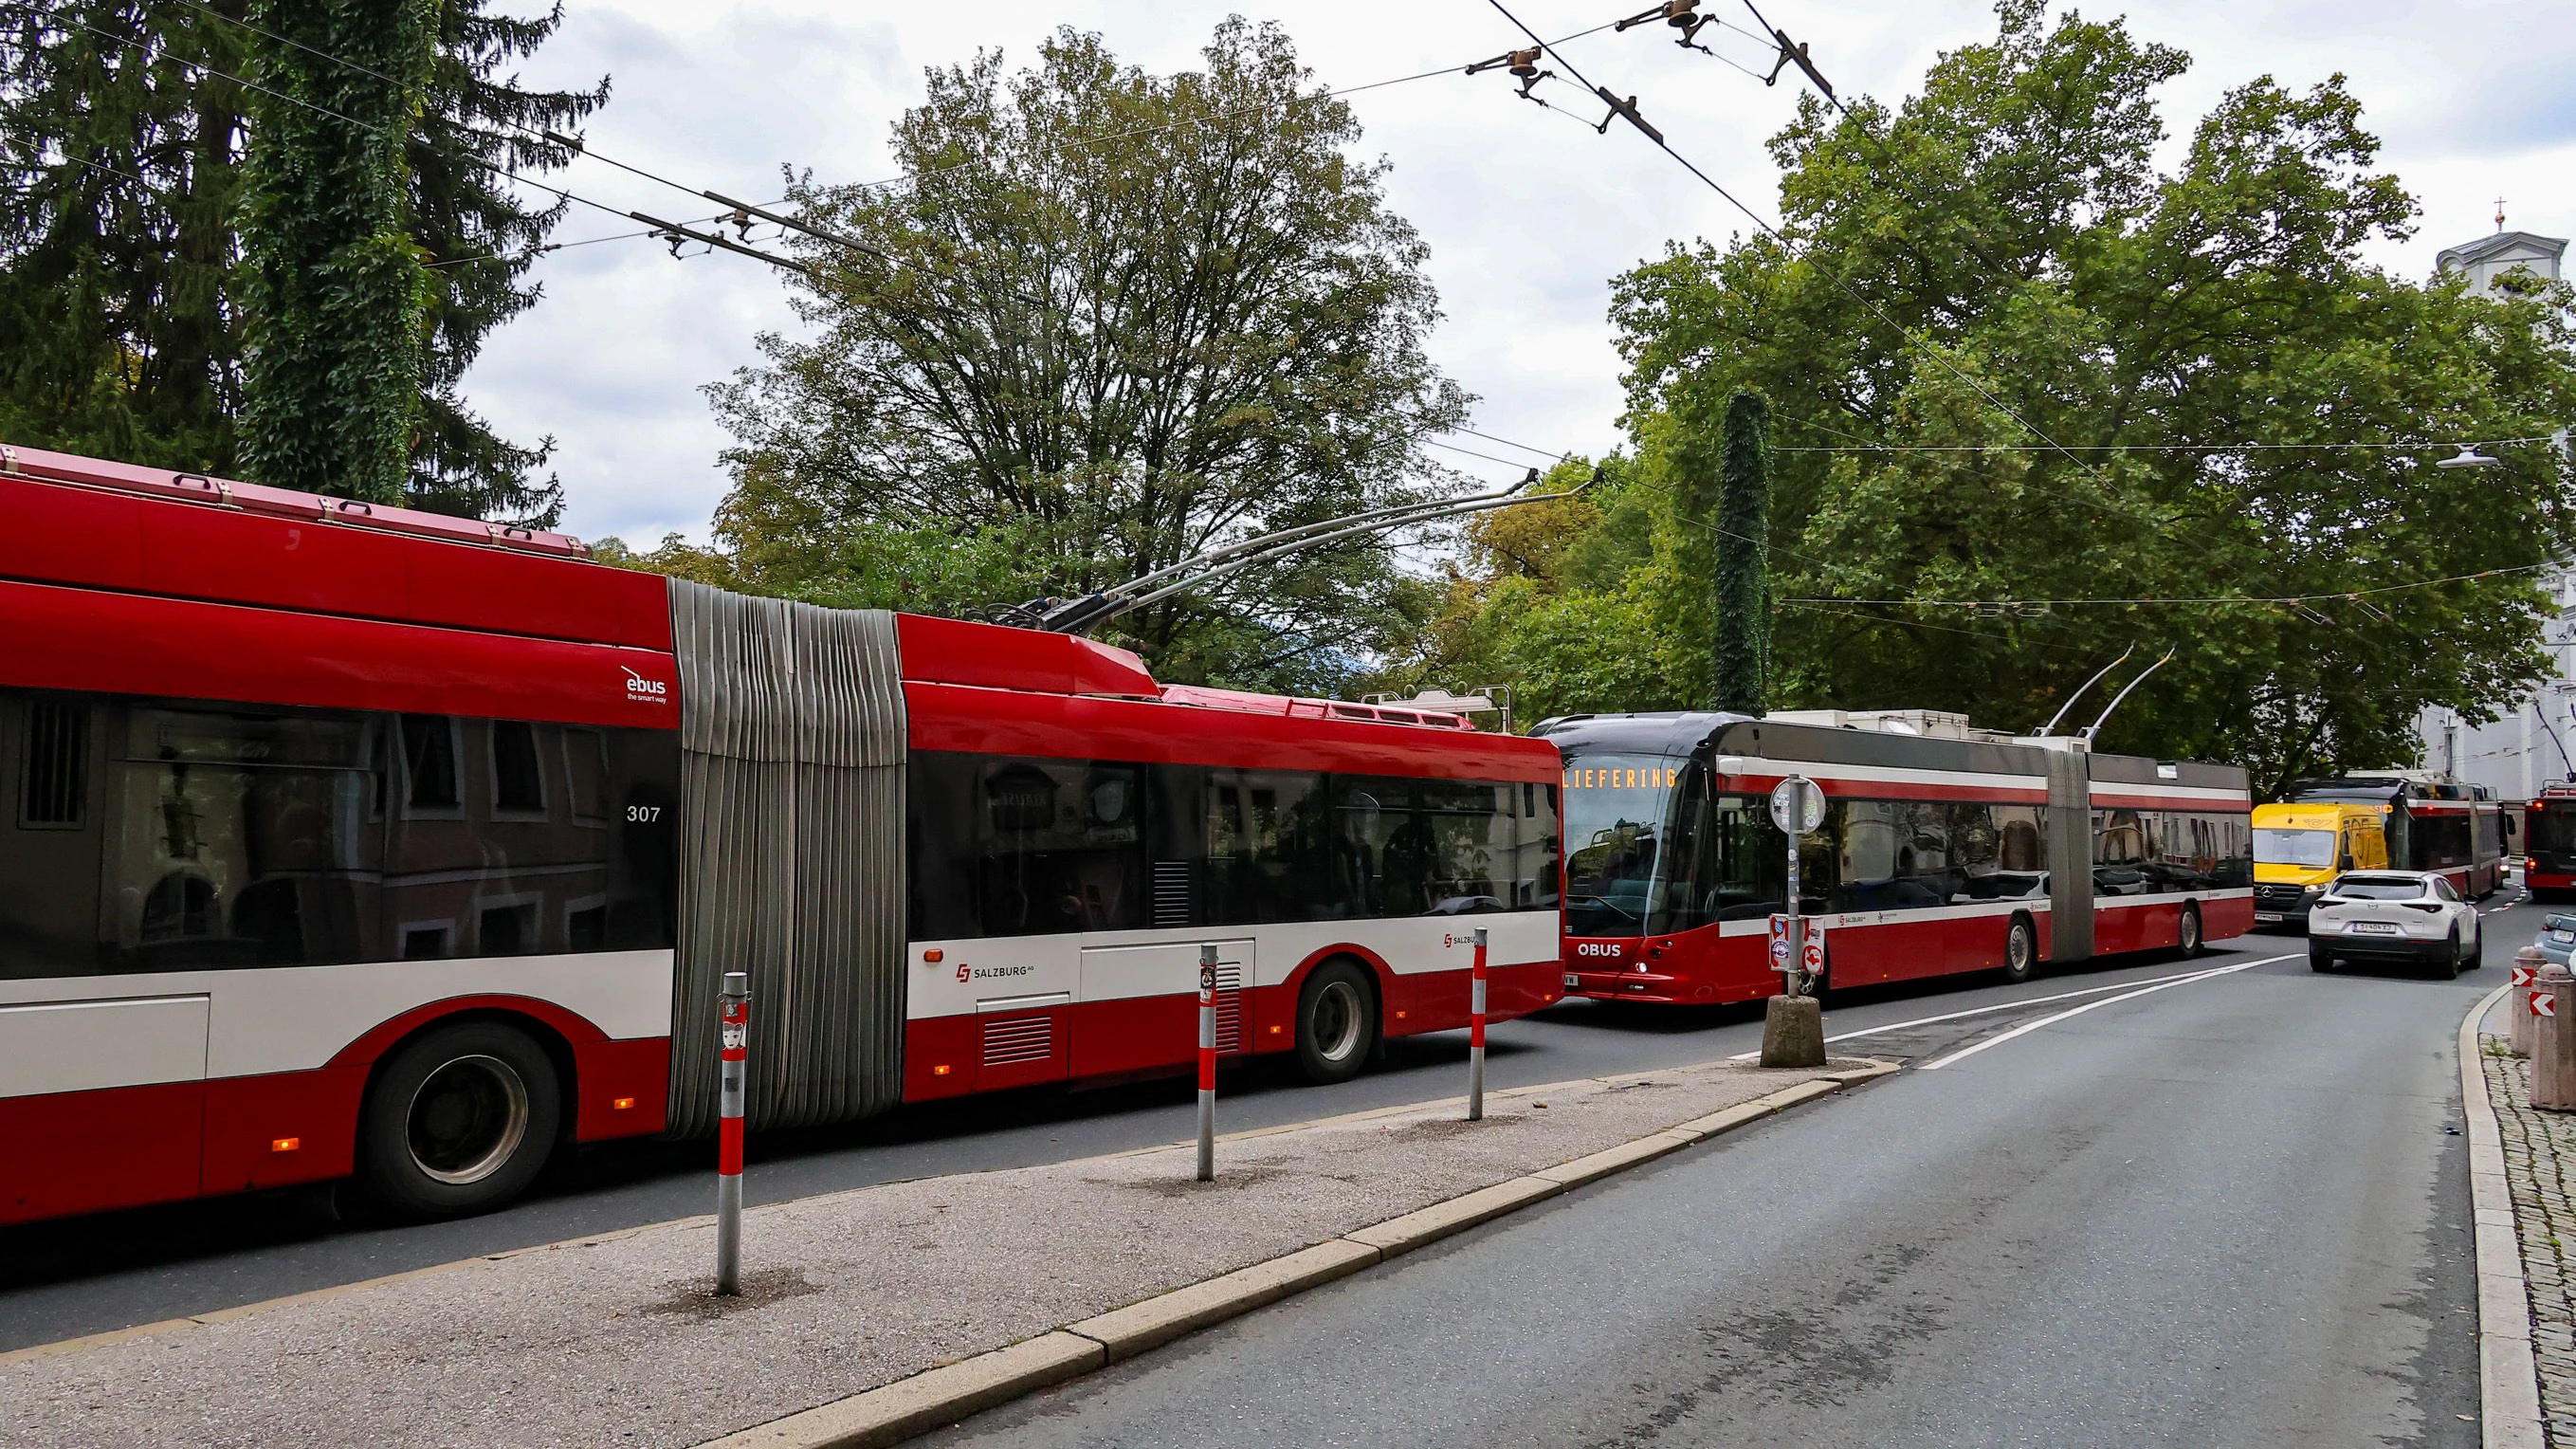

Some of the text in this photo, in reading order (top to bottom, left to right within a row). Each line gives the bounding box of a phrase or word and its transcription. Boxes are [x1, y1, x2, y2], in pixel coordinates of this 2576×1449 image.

[625, 673, 667, 694] ebus
[1562, 768, 1676, 788] LIEFERING
[627, 805, 661, 822] 307
[1453, 936, 1475, 945] SALZBU
[1578, 943, 1621, 957] OBUS
[974, 966, 1027, 979] SALZBURG
